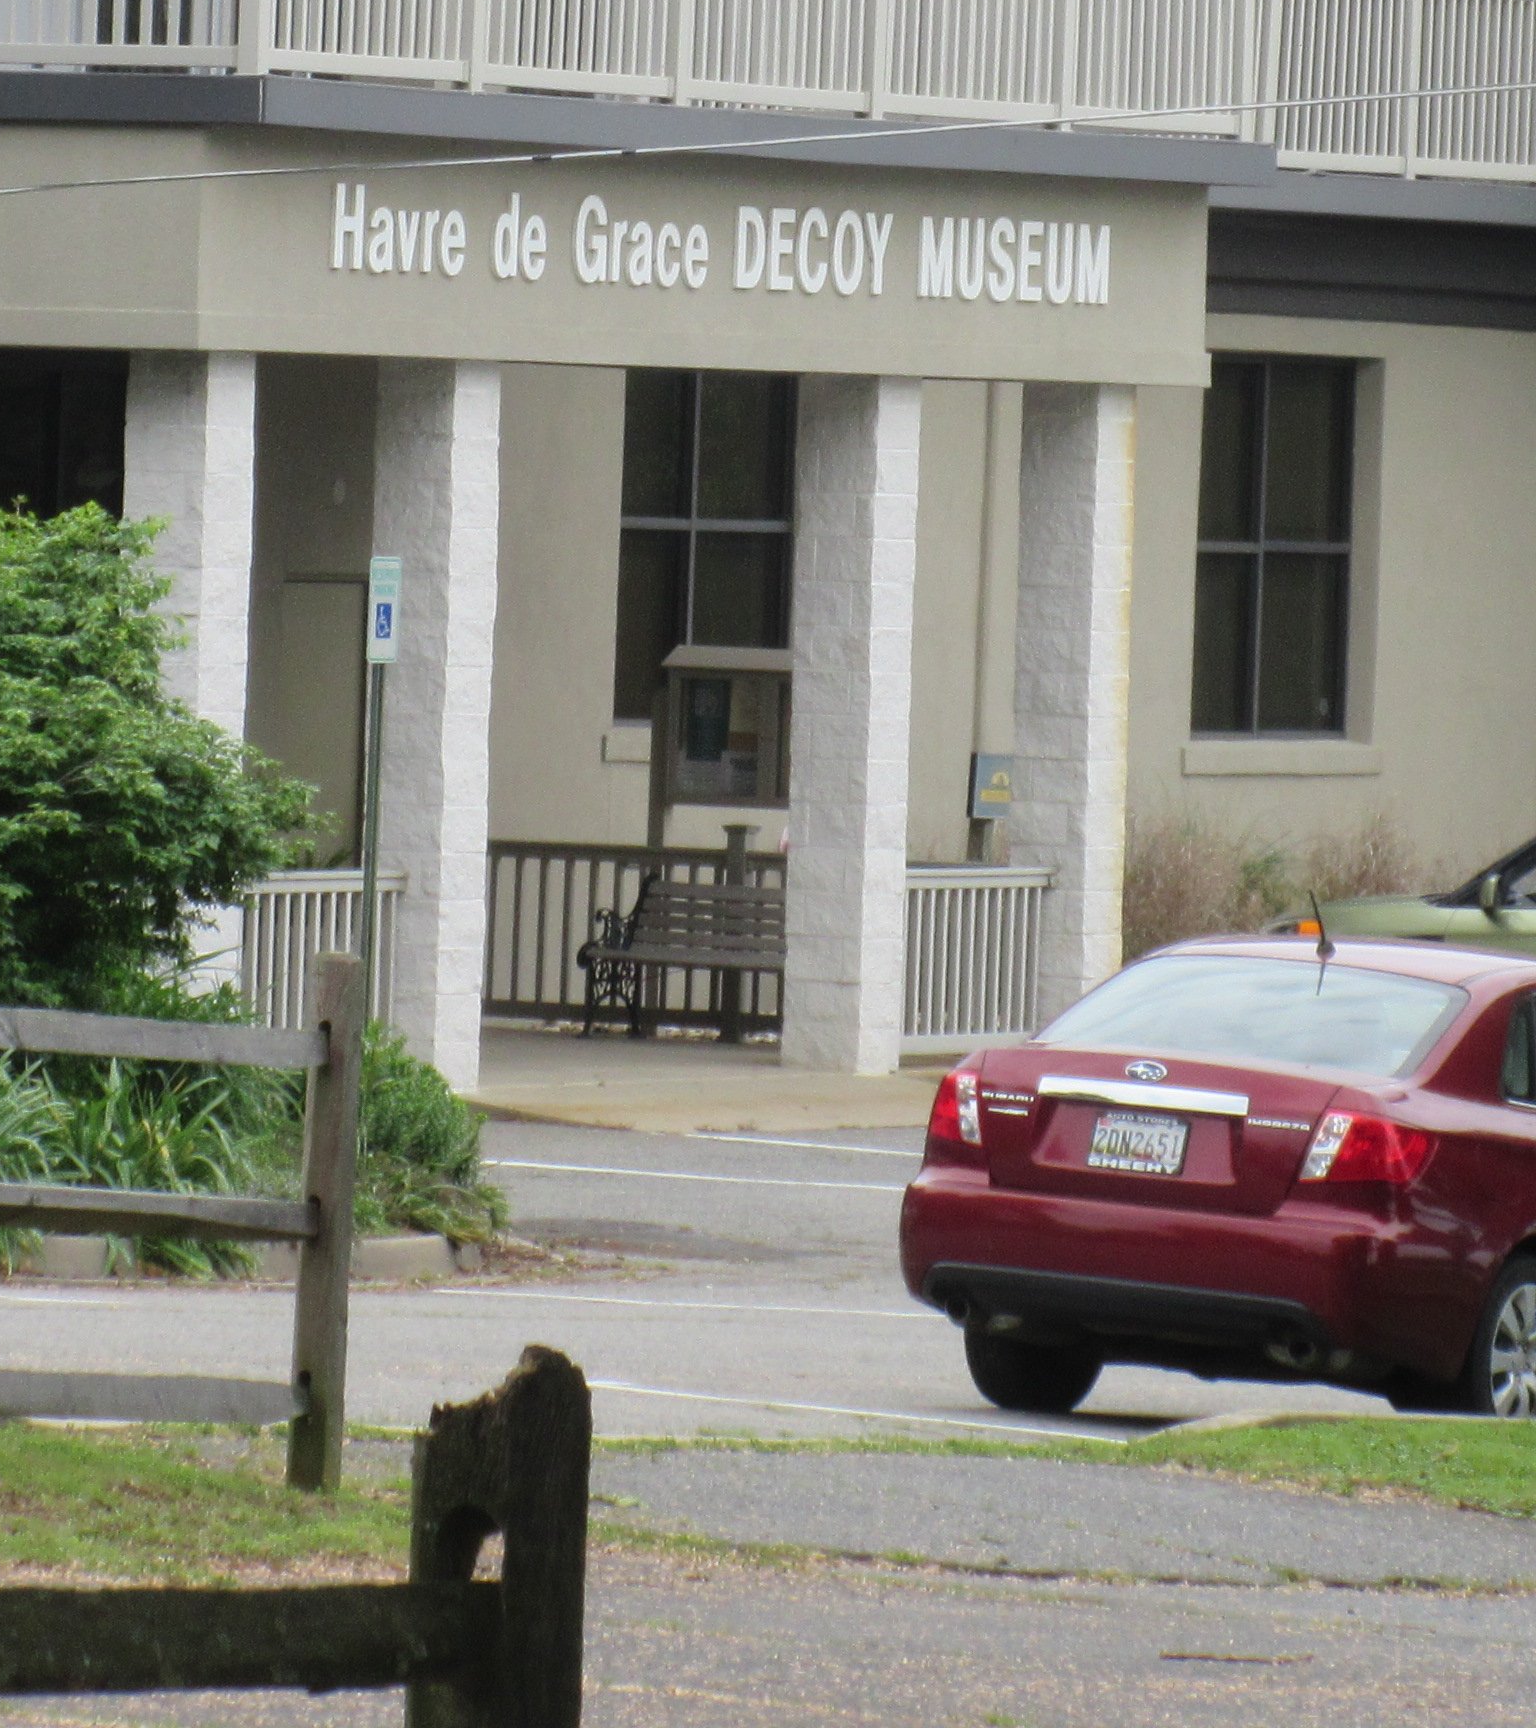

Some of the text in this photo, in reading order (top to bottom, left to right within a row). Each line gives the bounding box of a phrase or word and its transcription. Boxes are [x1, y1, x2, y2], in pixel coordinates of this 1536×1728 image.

[331, 182, 1112, 305] Havre de Grace DECOY MUSEUM
